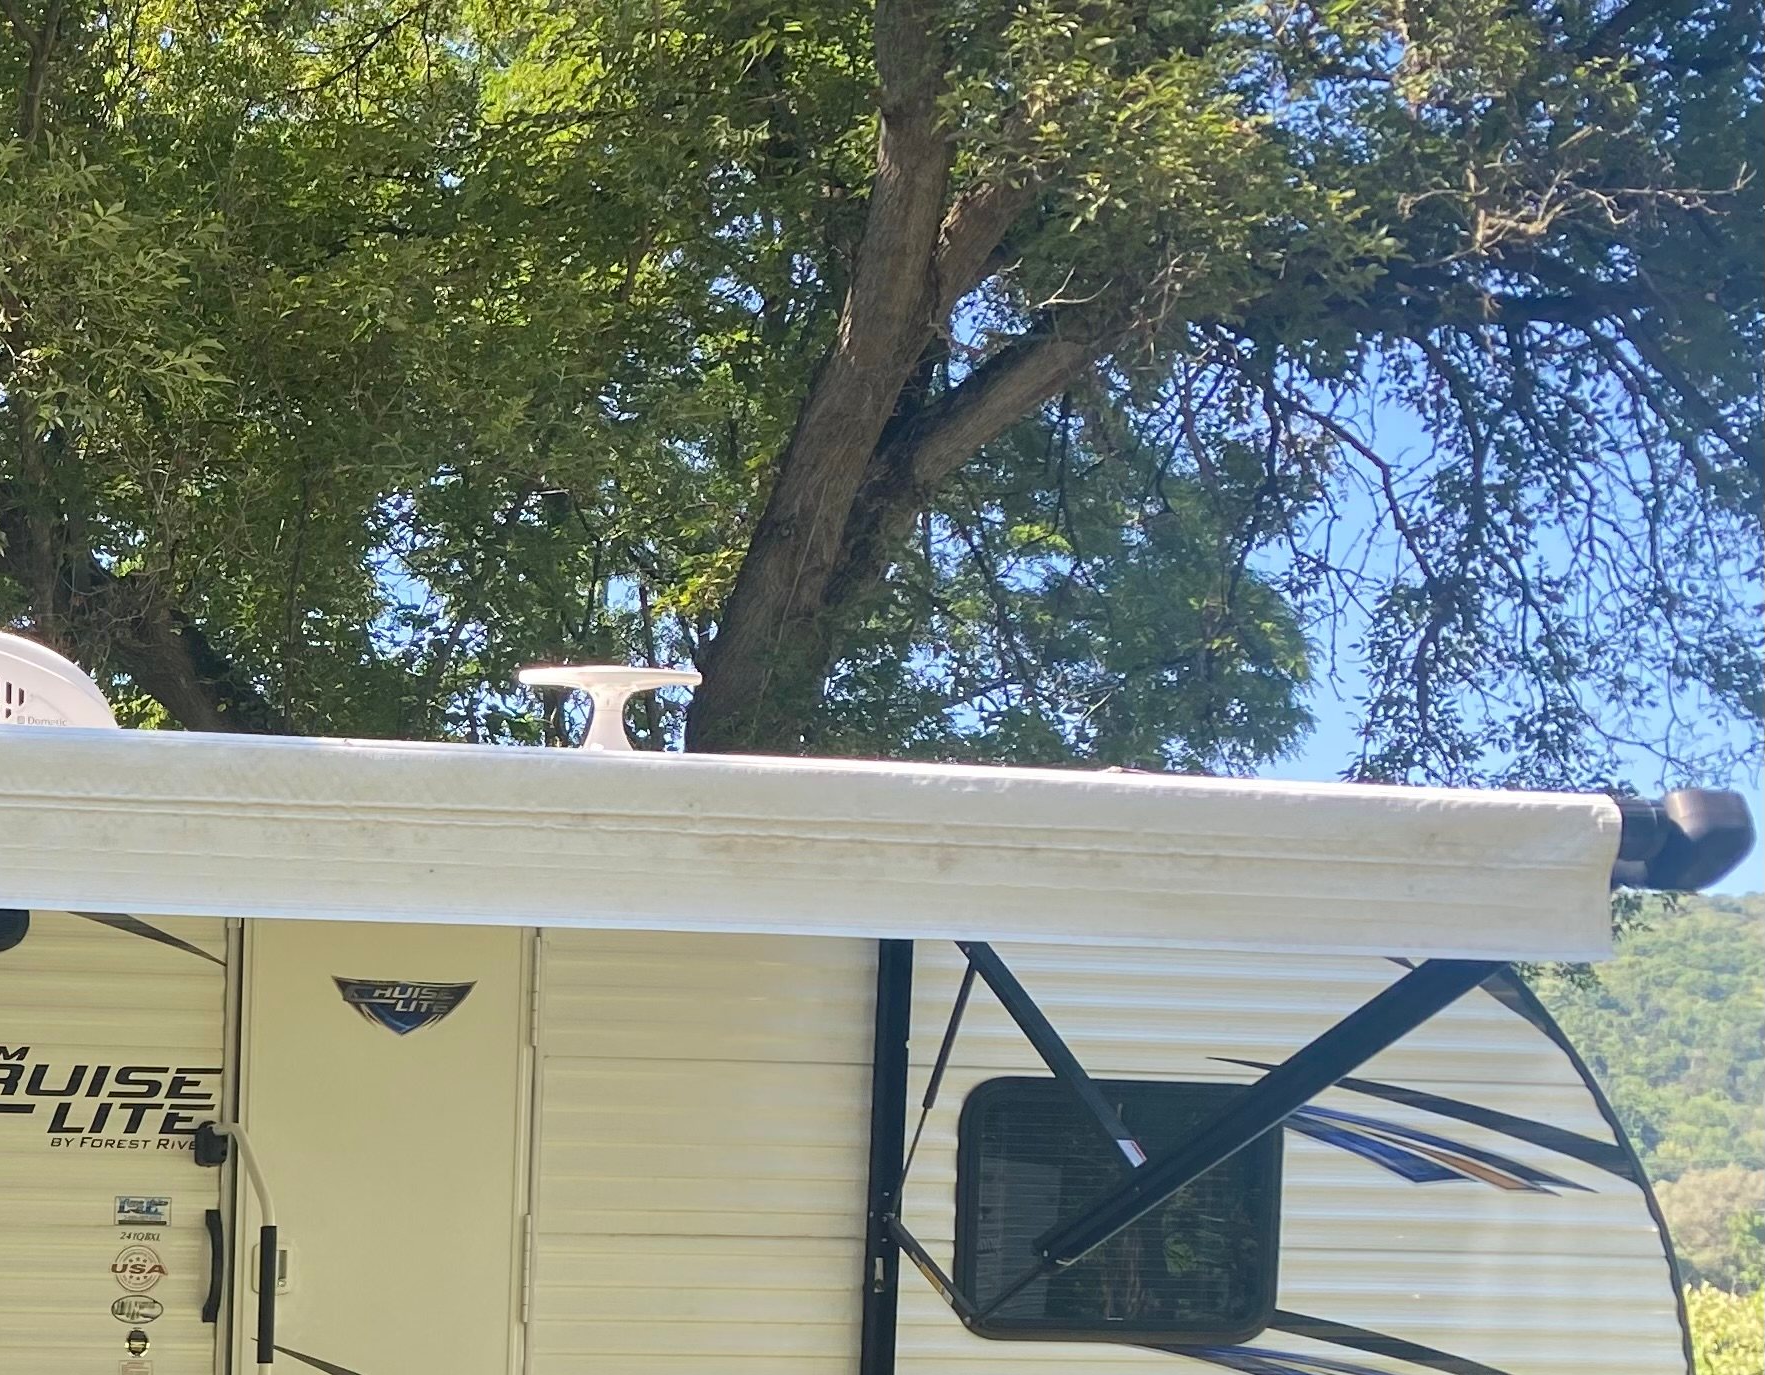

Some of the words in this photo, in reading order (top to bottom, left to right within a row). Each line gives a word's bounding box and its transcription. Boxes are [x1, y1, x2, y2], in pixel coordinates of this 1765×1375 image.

[27, 716, 68, 727] Dometic
[394, 1000, 449, 1013] LITE
[47, 1102, 217, 1135] LITE
[51, 1137, 75, 1149] BY
[156, 1138, 197, 1151] RIVE
[110, 1263, 168, 1276] USA
